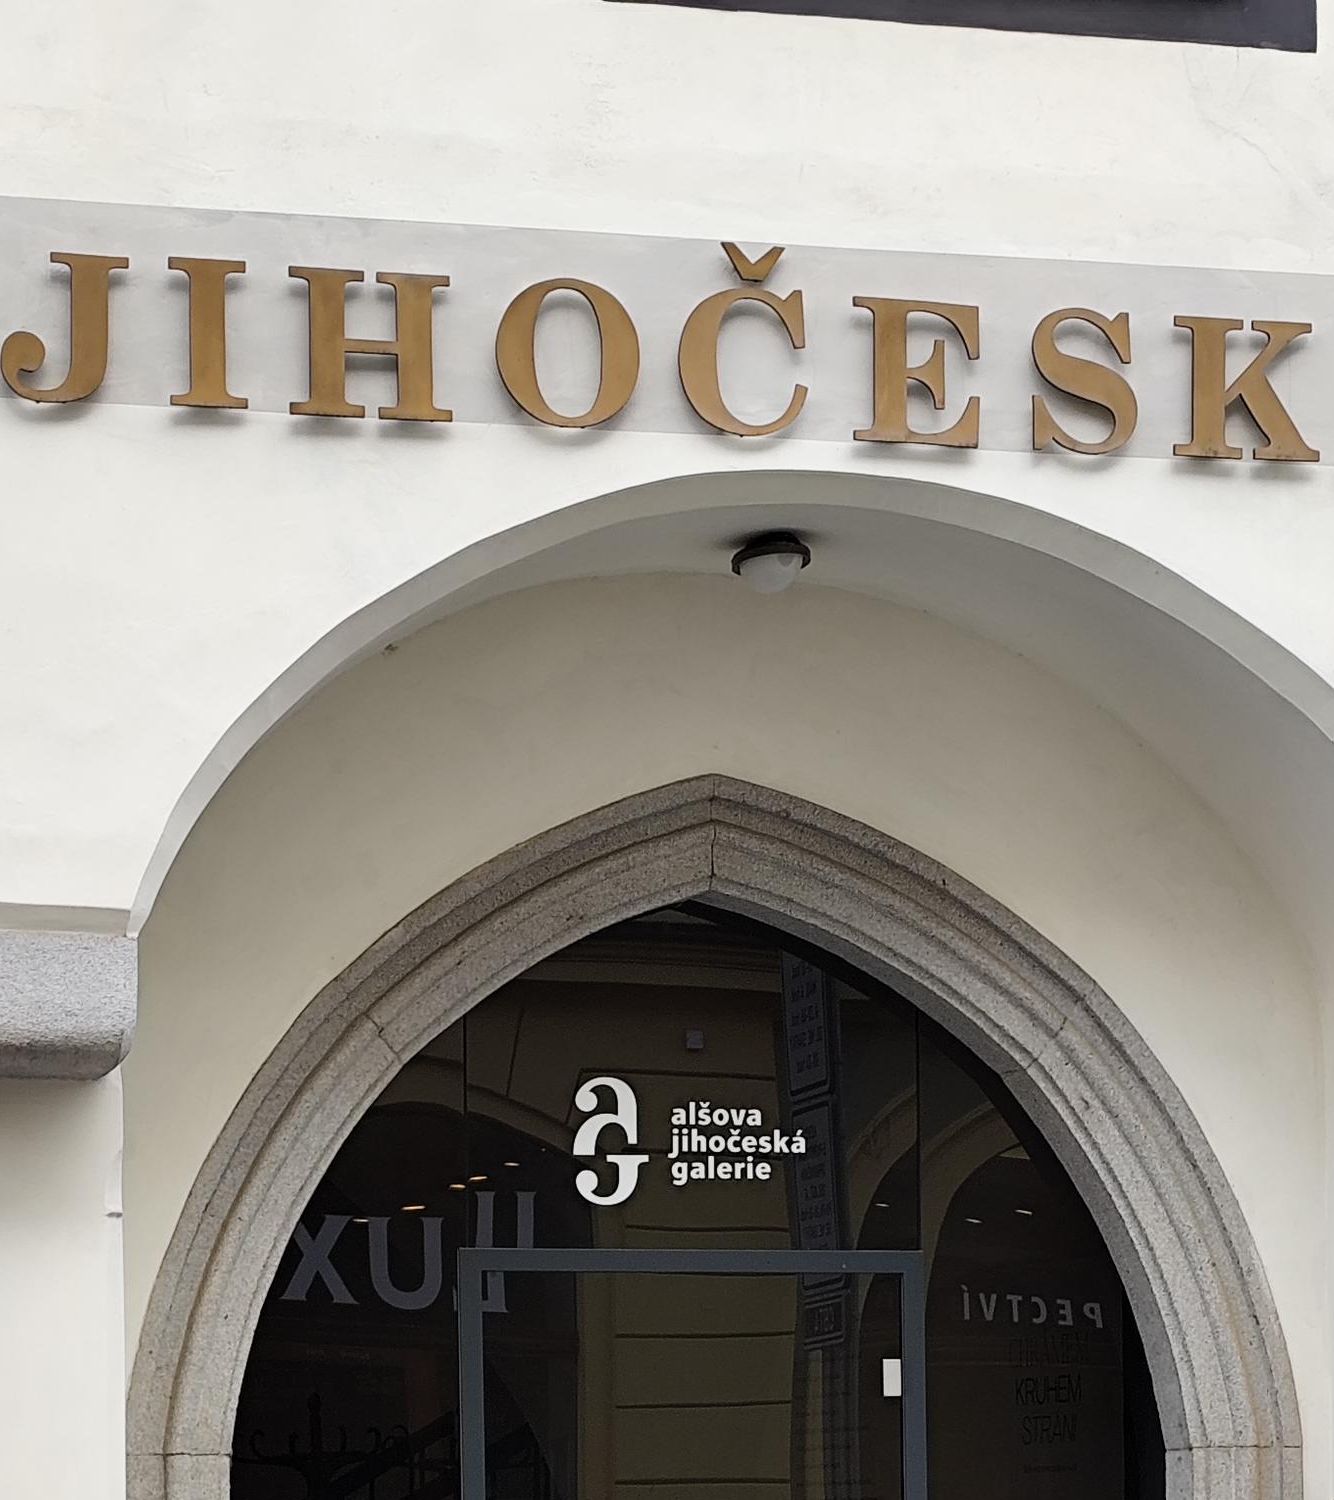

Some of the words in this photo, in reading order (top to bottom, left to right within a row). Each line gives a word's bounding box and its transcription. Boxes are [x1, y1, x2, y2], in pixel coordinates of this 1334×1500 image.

[670, 1101, 762, 1127] alšova
[667, 1128, 807, 1159] jihočeská
[671, 1155, 772, 1186] galerie
